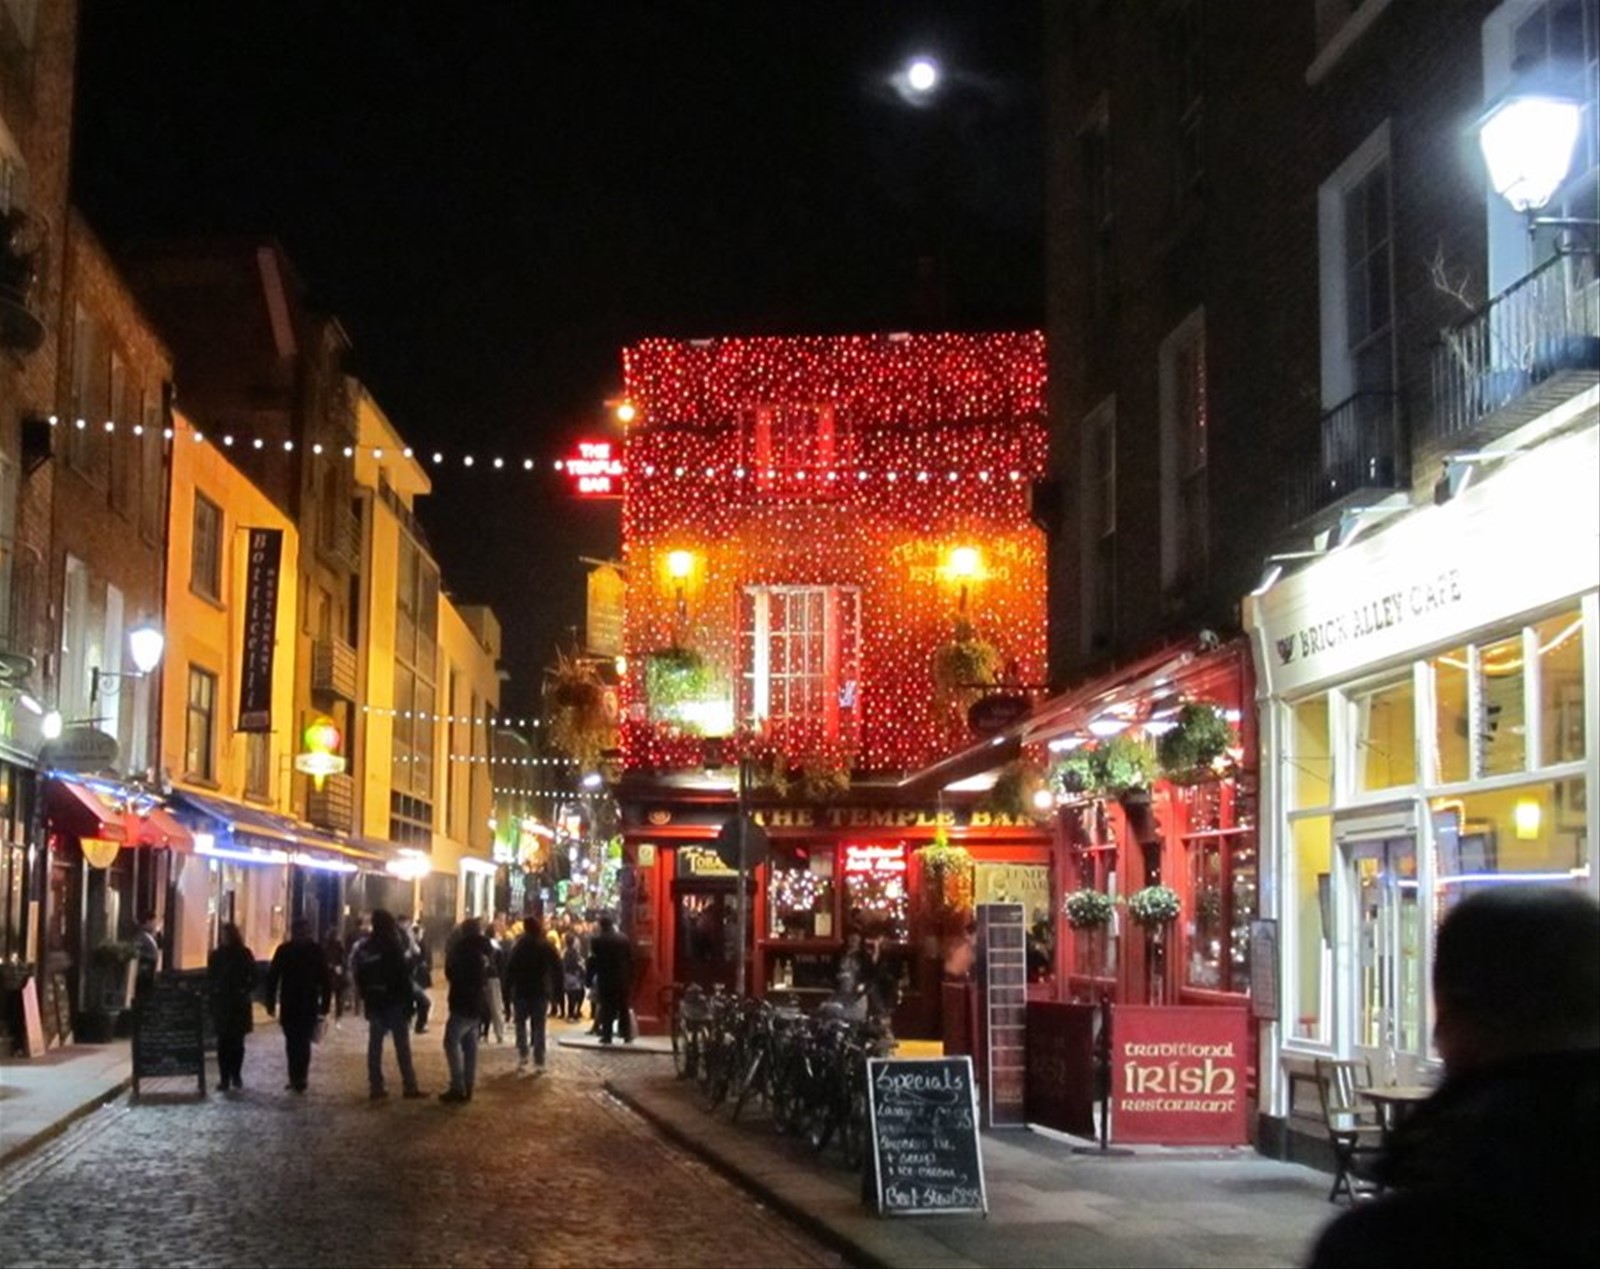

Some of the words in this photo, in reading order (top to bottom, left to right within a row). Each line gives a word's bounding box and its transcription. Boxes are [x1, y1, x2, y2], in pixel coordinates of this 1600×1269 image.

[578, 443, 610, 459] THE
[578, 477, 610, 492] BAR
[1299, 613, 1348, 659] BRICK
[1352, 592, 1403, 640] ALLEY
[753, 808, 814, 827] THE
[826, 808, 956, 827] TEMPLE
[969, 808, 1036, 827] BAR
[1124, 1042, 1236, 1058] traditional
[876, 1063, 964, 1096] Specials
[1121, 1098, 1237, 1113] restaurant
